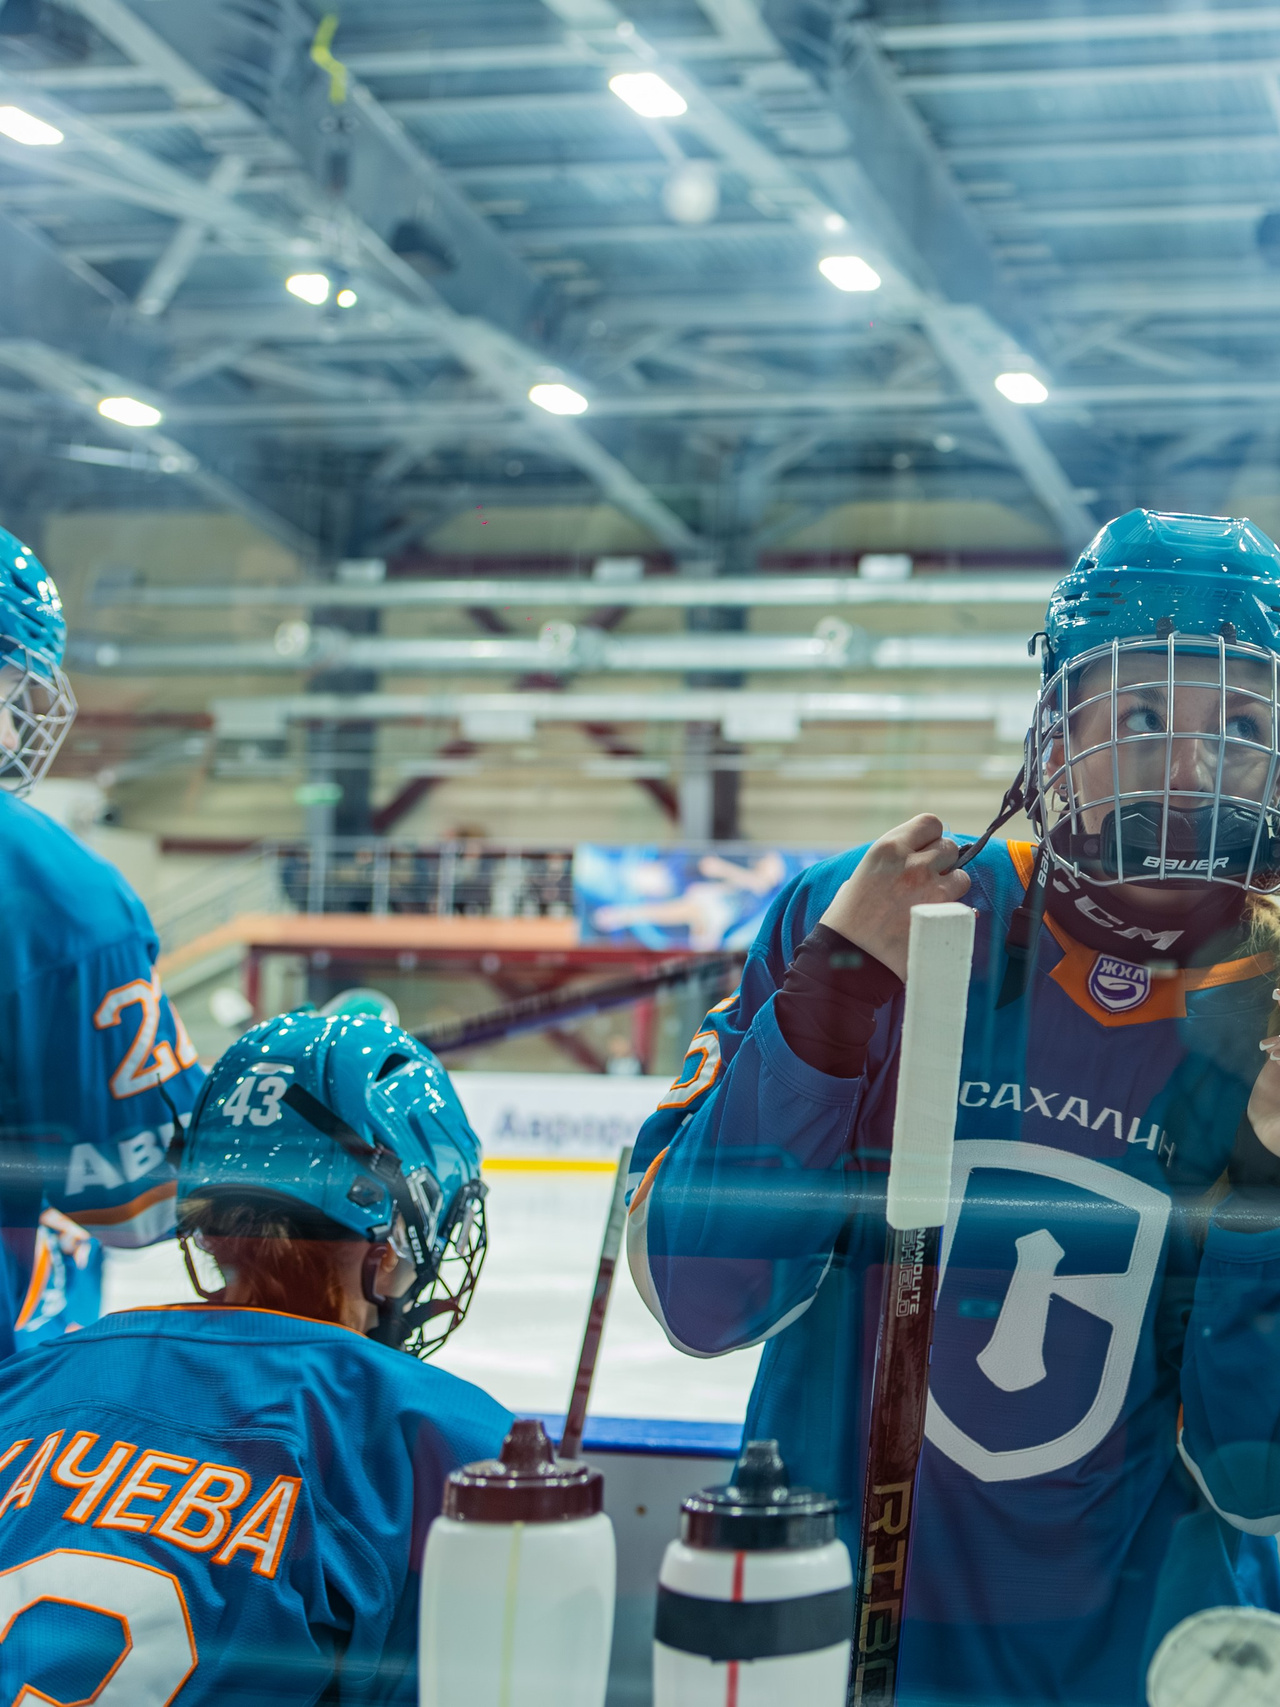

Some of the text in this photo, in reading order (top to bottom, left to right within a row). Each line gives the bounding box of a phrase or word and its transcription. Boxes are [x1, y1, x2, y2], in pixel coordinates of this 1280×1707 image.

[1037, 848, 1050, 889] BAU
[1143, 855, 1229, 871] BAUER
[1052, 862, 1186, 951] CCM
[1099, 959, 1146, 982] ЖХЛ
[222, 1076, 288, 1127] 43
[497, 1107, 638, 1149] Аврор
[959, 1081, 1176, 1168] САХАЛИН
[407, 1225, 425, 1265] CCM
[909, 1228, 926, 1315] NANOLITE
